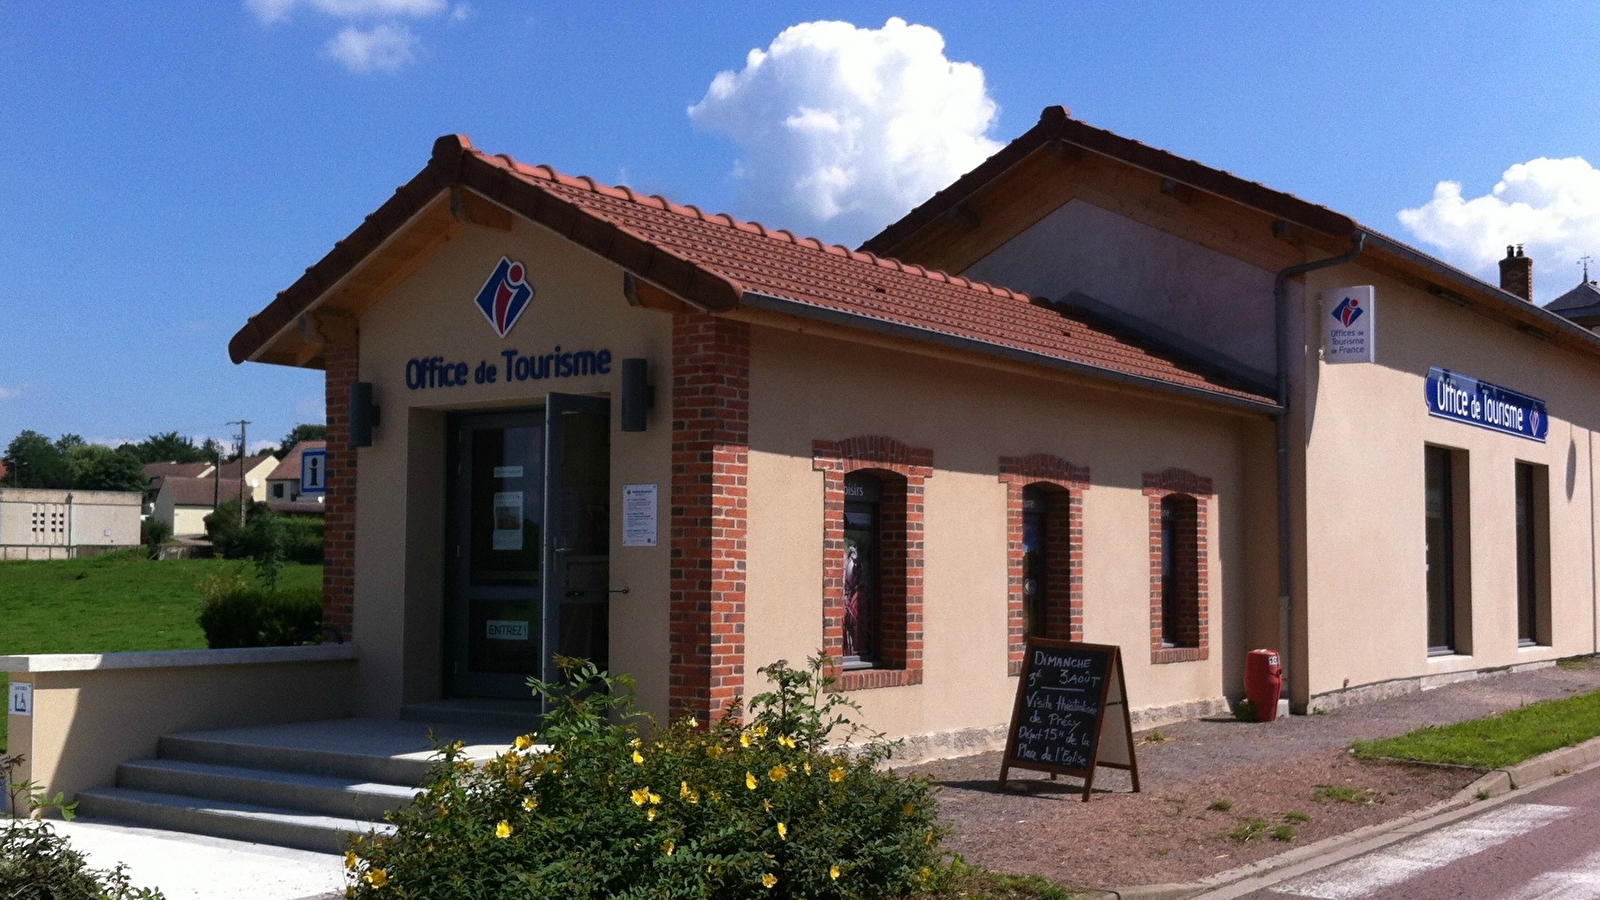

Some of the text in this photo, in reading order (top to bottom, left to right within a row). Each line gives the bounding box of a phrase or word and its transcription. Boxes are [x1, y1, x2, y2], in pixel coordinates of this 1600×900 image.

[1331, 329, 1355, 337] Offices
[1338, 346, 1365, 354] France
[406, 346, 611, 390] Office de Tourisme
[1437, 376, 1523, 431] Office de Tourisme
[844, 483, 864, 496] oisirs
[488, 624, 522, 636] ENTREZ
[1026, 691, 1053, 709] Visite
[1029, 710, 1042, 723] de
[1018, 726, 1043, 744] Départ
[1065, 733, 1077, 745] de
[1081, 733, 1090, 746] la
[1017, 743, 1038, 761] Place
[1041, 746, 1053, 761] de
